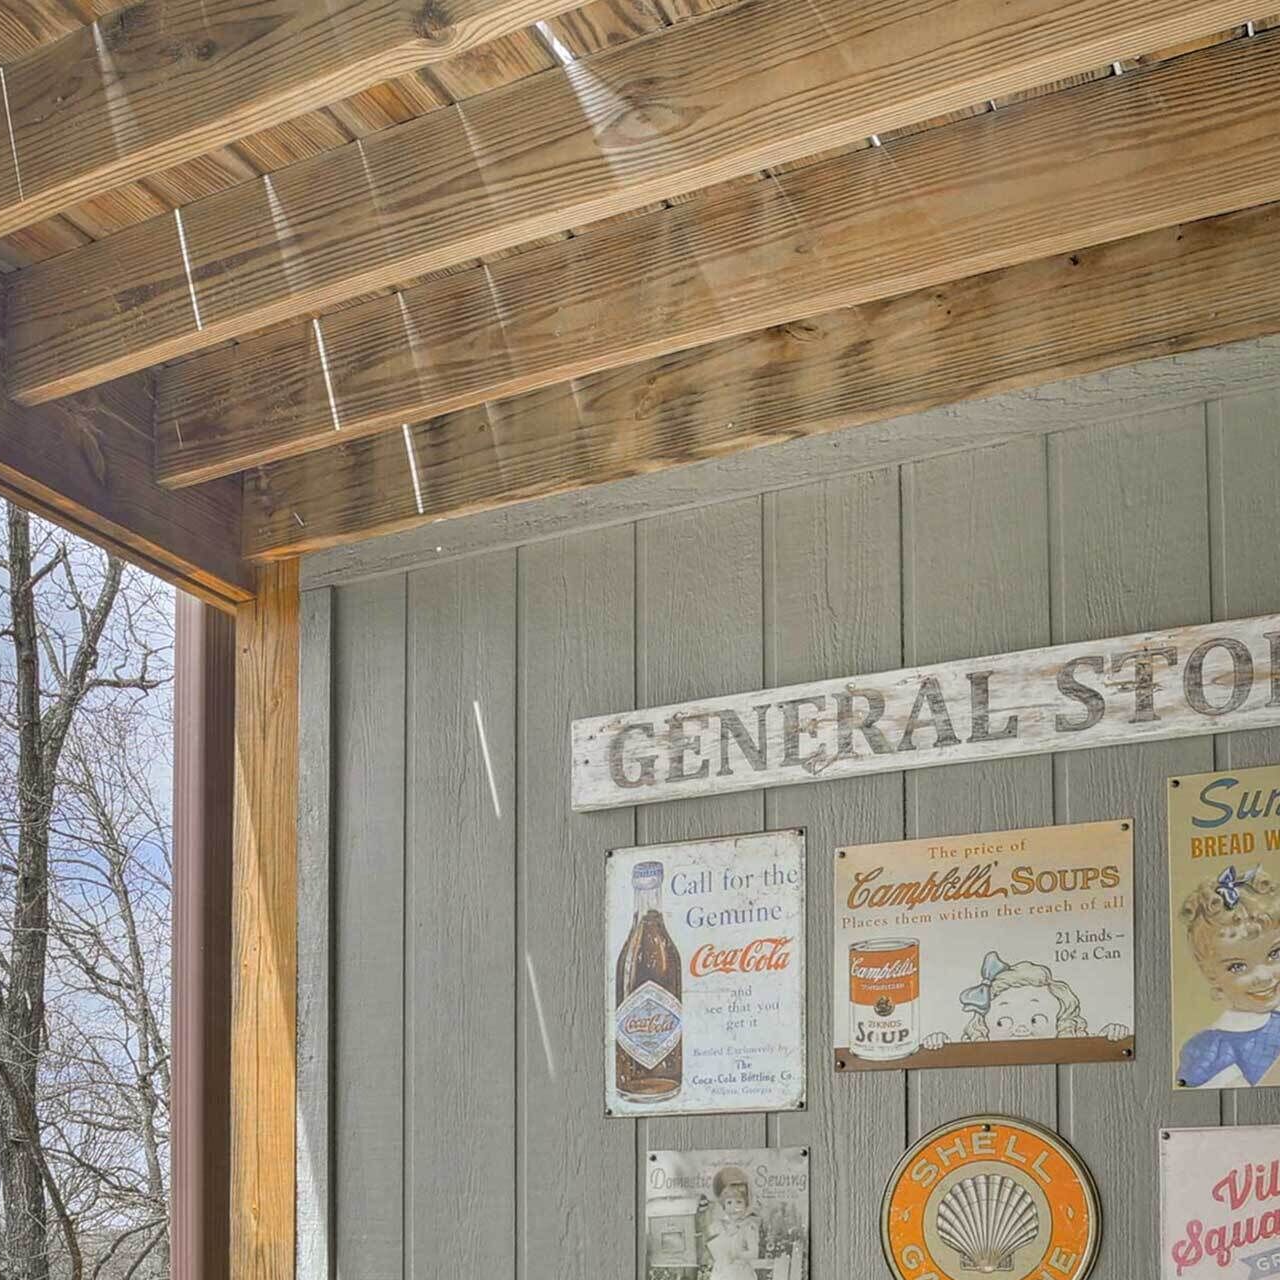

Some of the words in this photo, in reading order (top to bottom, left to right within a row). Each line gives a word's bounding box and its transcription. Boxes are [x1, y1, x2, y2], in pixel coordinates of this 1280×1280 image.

[607, 670, 1019, 790] GENERAL
[928, 845, 957, 859] The
[964, 843, 1003, 859] price
[1010, 839, 1028, 852] of
[1191, 831, 1255, 859] BREAD
[671, 870, 712, 897] Call
[723, 867, 755, 889] for
[764, 863, 798, 887] the
[686, 901, 783, 928] Genuine
[841, 915, 888, 929] Places
[895, 911, 932, 925] them
[939, 906, 989, 921] within
[997, 902, 1022, 916] the
[1029, 900, 1072, 915] reach
[1080, 897, 1097, 910] of
[1103, 896, 1124, 909] all
[1055, 932, 1070, 944] 21
[1081, 951, 1090, 961] a
[1092, 946, 1121, 960] Can
[730, 985, 752, 997] and
[728, 1001, 750, 1013] that
[911, 1131, 1052, 1188] SHELL
